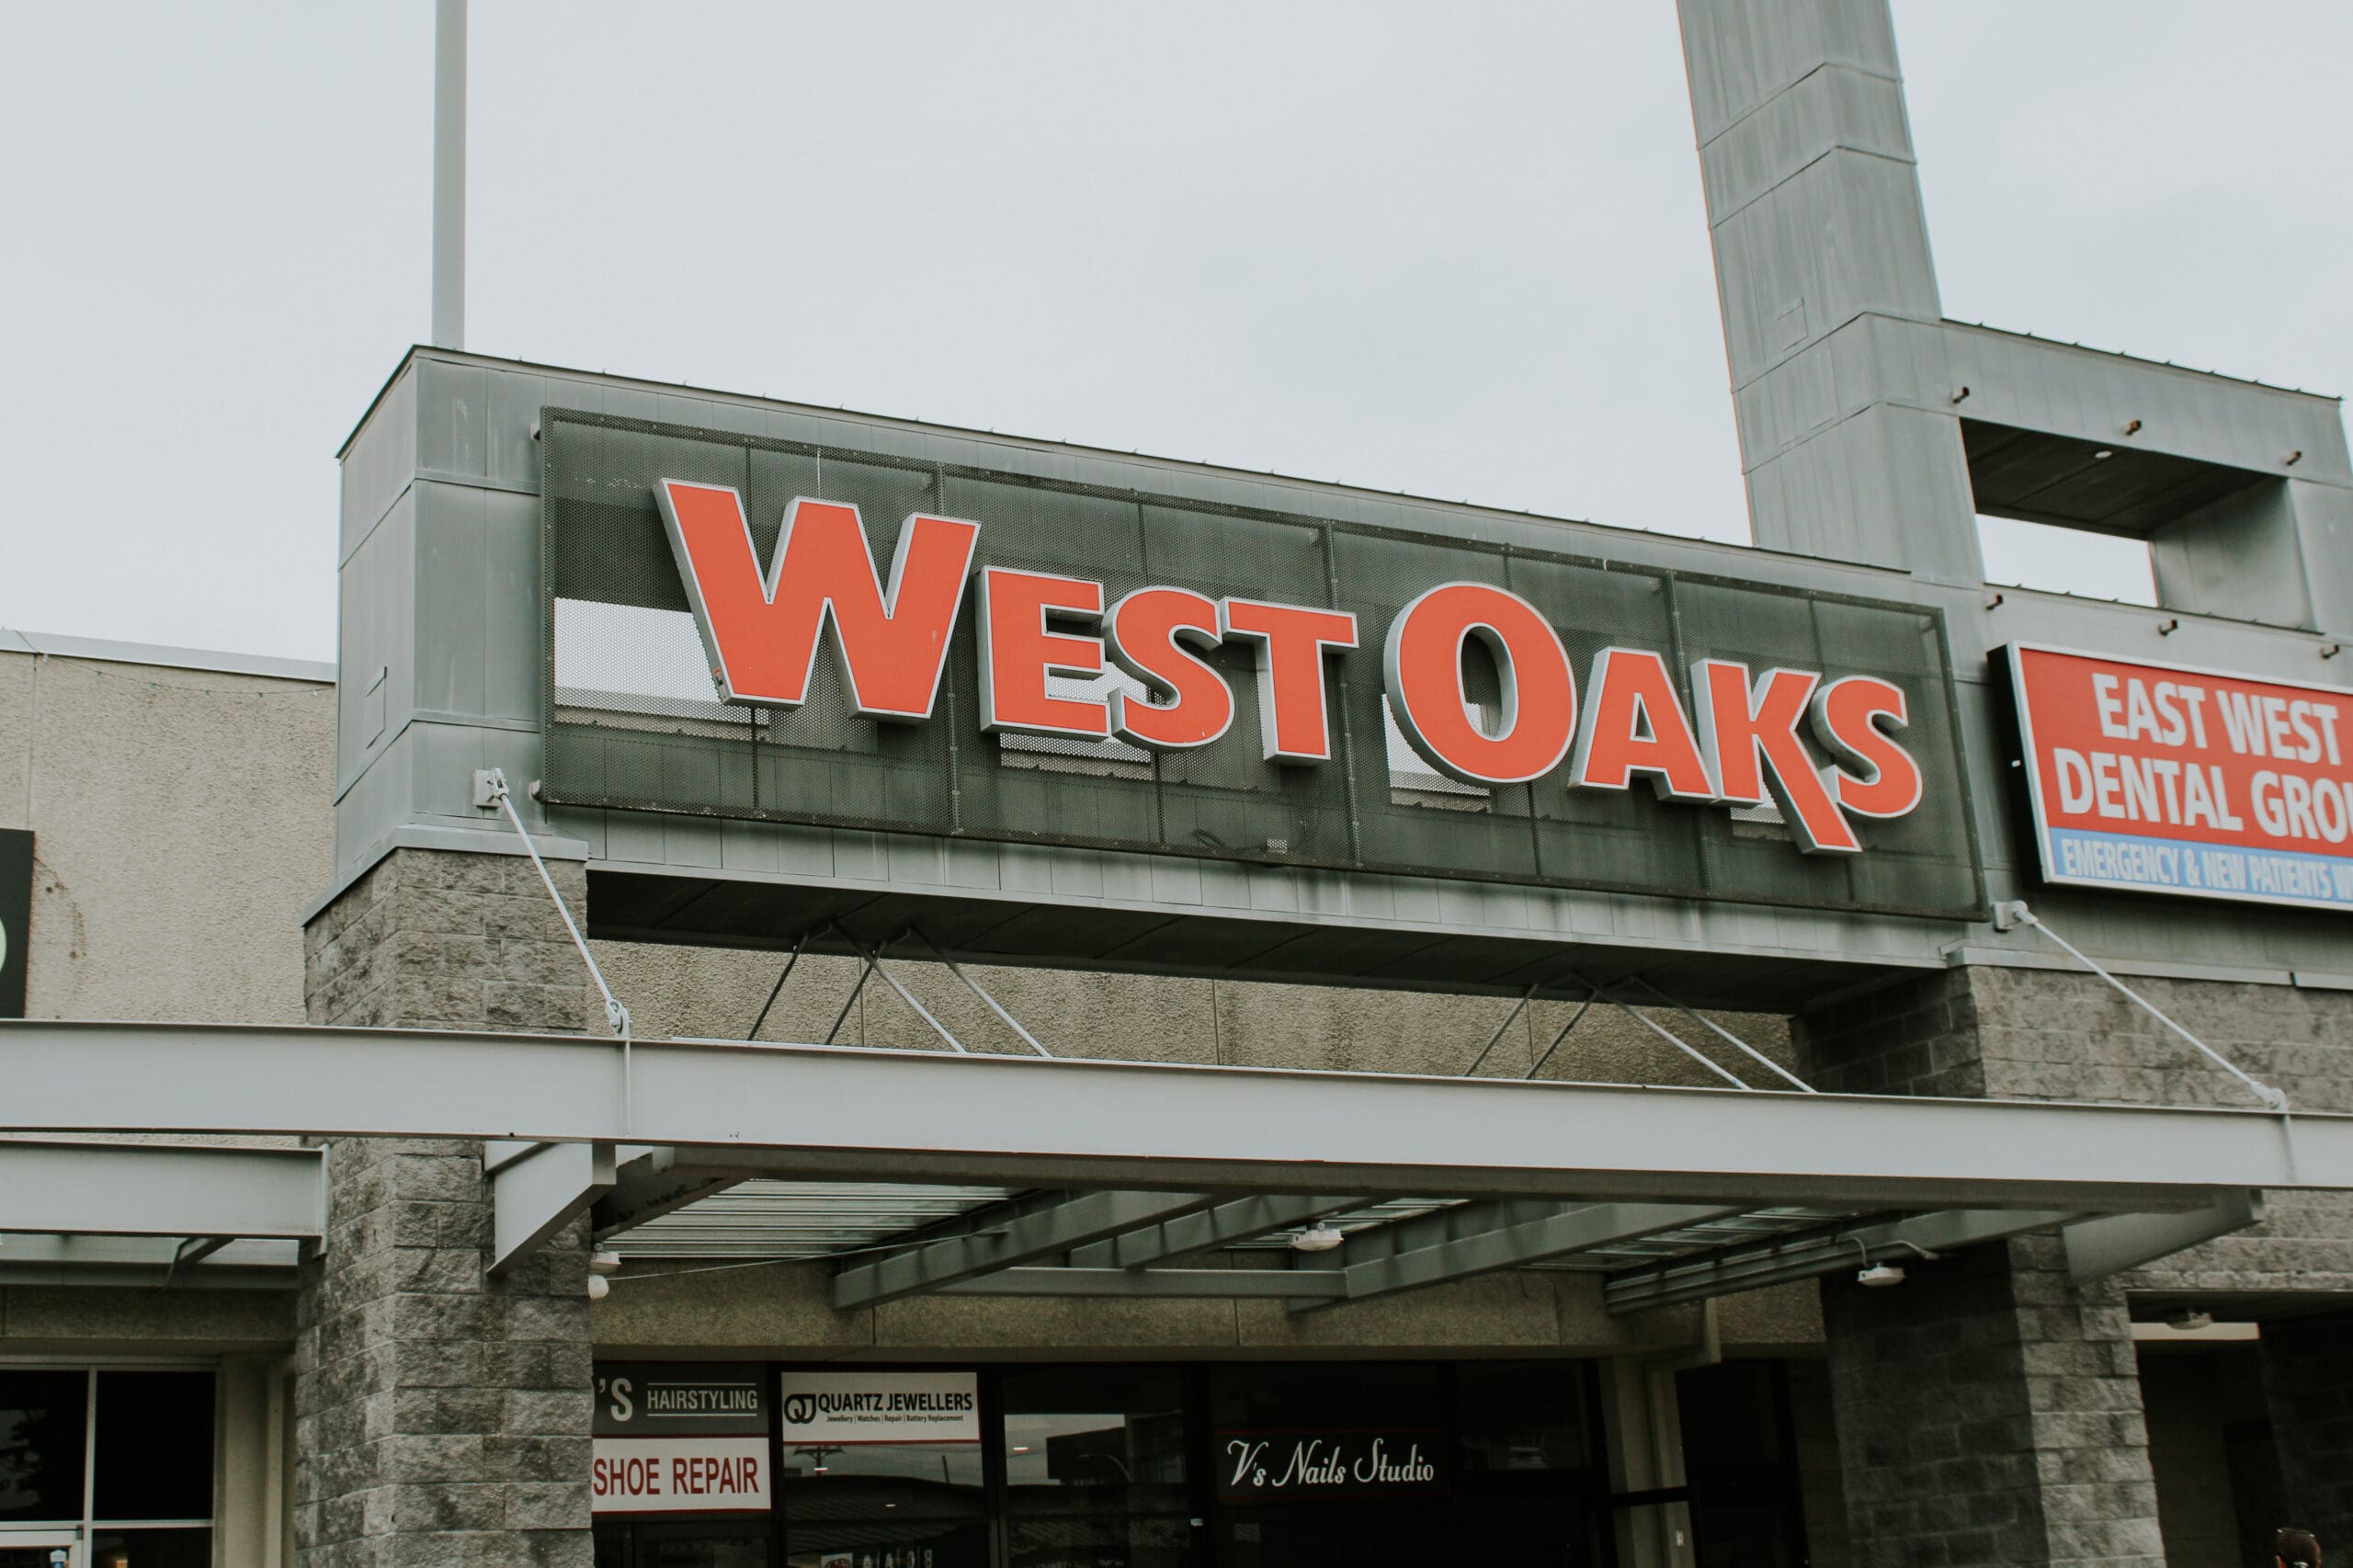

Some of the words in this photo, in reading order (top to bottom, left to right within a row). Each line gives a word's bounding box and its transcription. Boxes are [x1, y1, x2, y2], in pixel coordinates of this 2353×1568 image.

[653, 476, 1359, 766] WEST
[1383, 580, 1925, 857] OAKS
[2091, 672, 2208, 749] EAST
[2215, 688, 2342, 766] WEST
[2052, 746, 2244, 833] DENTAL
[2060, 836, 2180, 885] EMERGENCY
[2183, 847, 2202, 886] &
[2201, 849, 2247, 892] NEW
[2248, 855, 2333, 900] PATIENTS
[647, 1390, 758, 1410] HAIRSTYLING
[817, 1392, 883, 1413] QUARTZ
[886, 1392, 972, 1412] JEWELLERS
[593, 1458, 660, 1496] SHOE
[672, 1457, 759, 1495] REPAIR
[1227, 1439, 1269, 1486] V's
[1272, 1439, 1347, 1486] Nails
[1354, 1437, 1434, 1483] Studio
